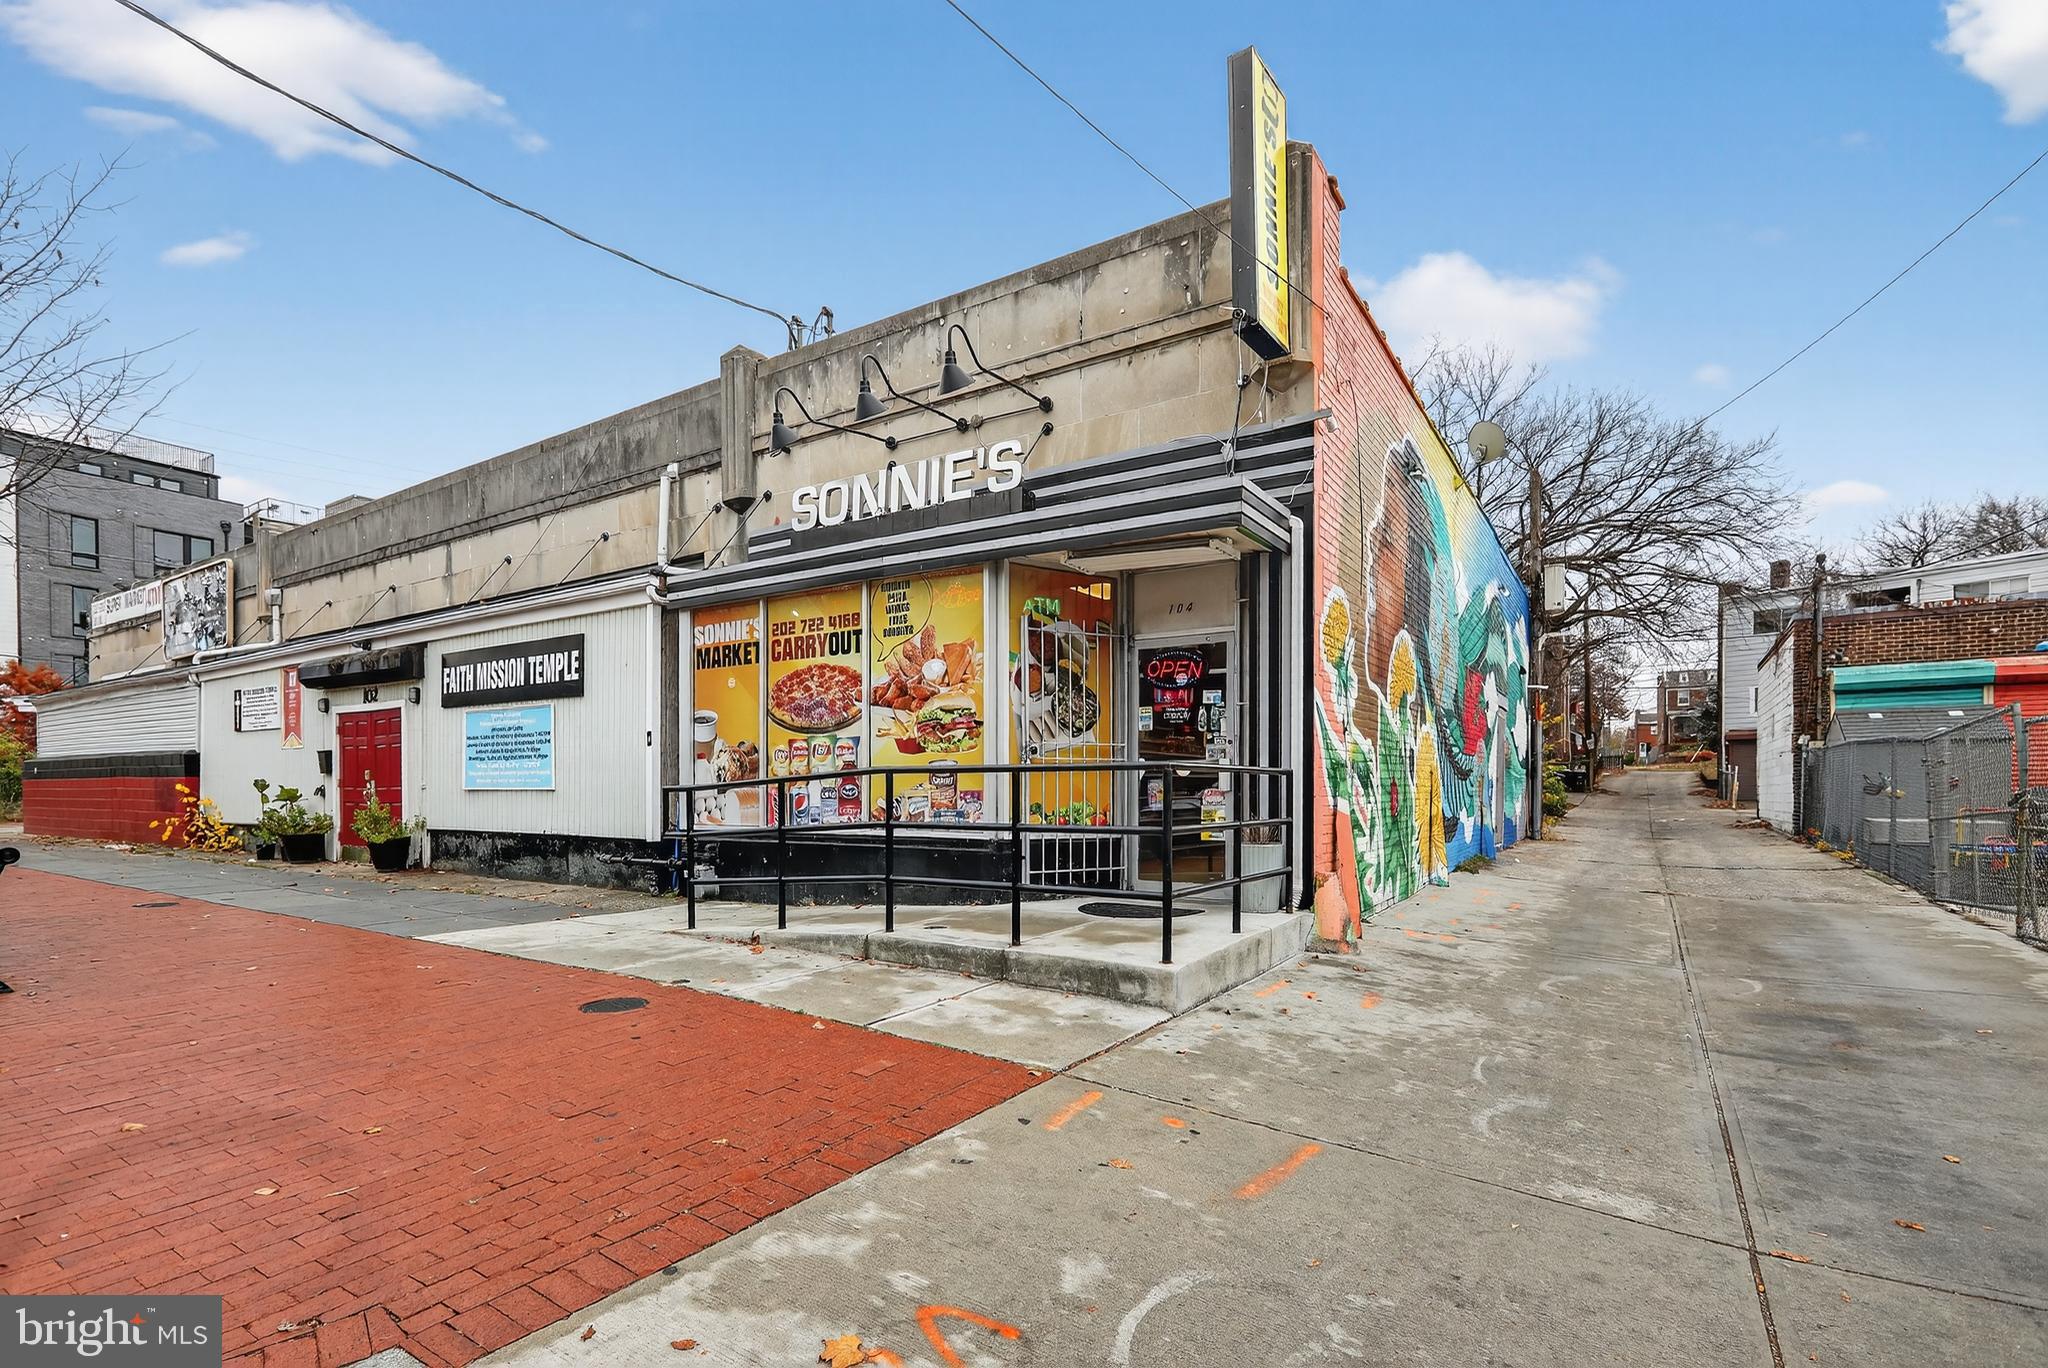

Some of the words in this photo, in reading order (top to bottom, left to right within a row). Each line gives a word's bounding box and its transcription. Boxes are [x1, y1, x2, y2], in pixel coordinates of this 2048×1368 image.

[1263, 118, 1279, 290] SONNIE'S
[792, 440, 1024, 532] SONNIE'S
[1023, 597, 1061, 616] ATM
[1169, 602, 1193, 615] 104
[694, 617, 760, 646] SONNIE'S
[772, 621, 796, 637] 202
[801, 617, 824, 633] 722
[696, 641, 760, 670] MARKET
[771, 629, 862, 662] CARRYOUT
[443, 664, 474, 695] FAITH
[476, 657, 525, 690] MISSION
[528, 650, 580, 685] TEMPLE
[1147, 660, 1203, 679] OPEN
[363, 685, 378, 704] 102
